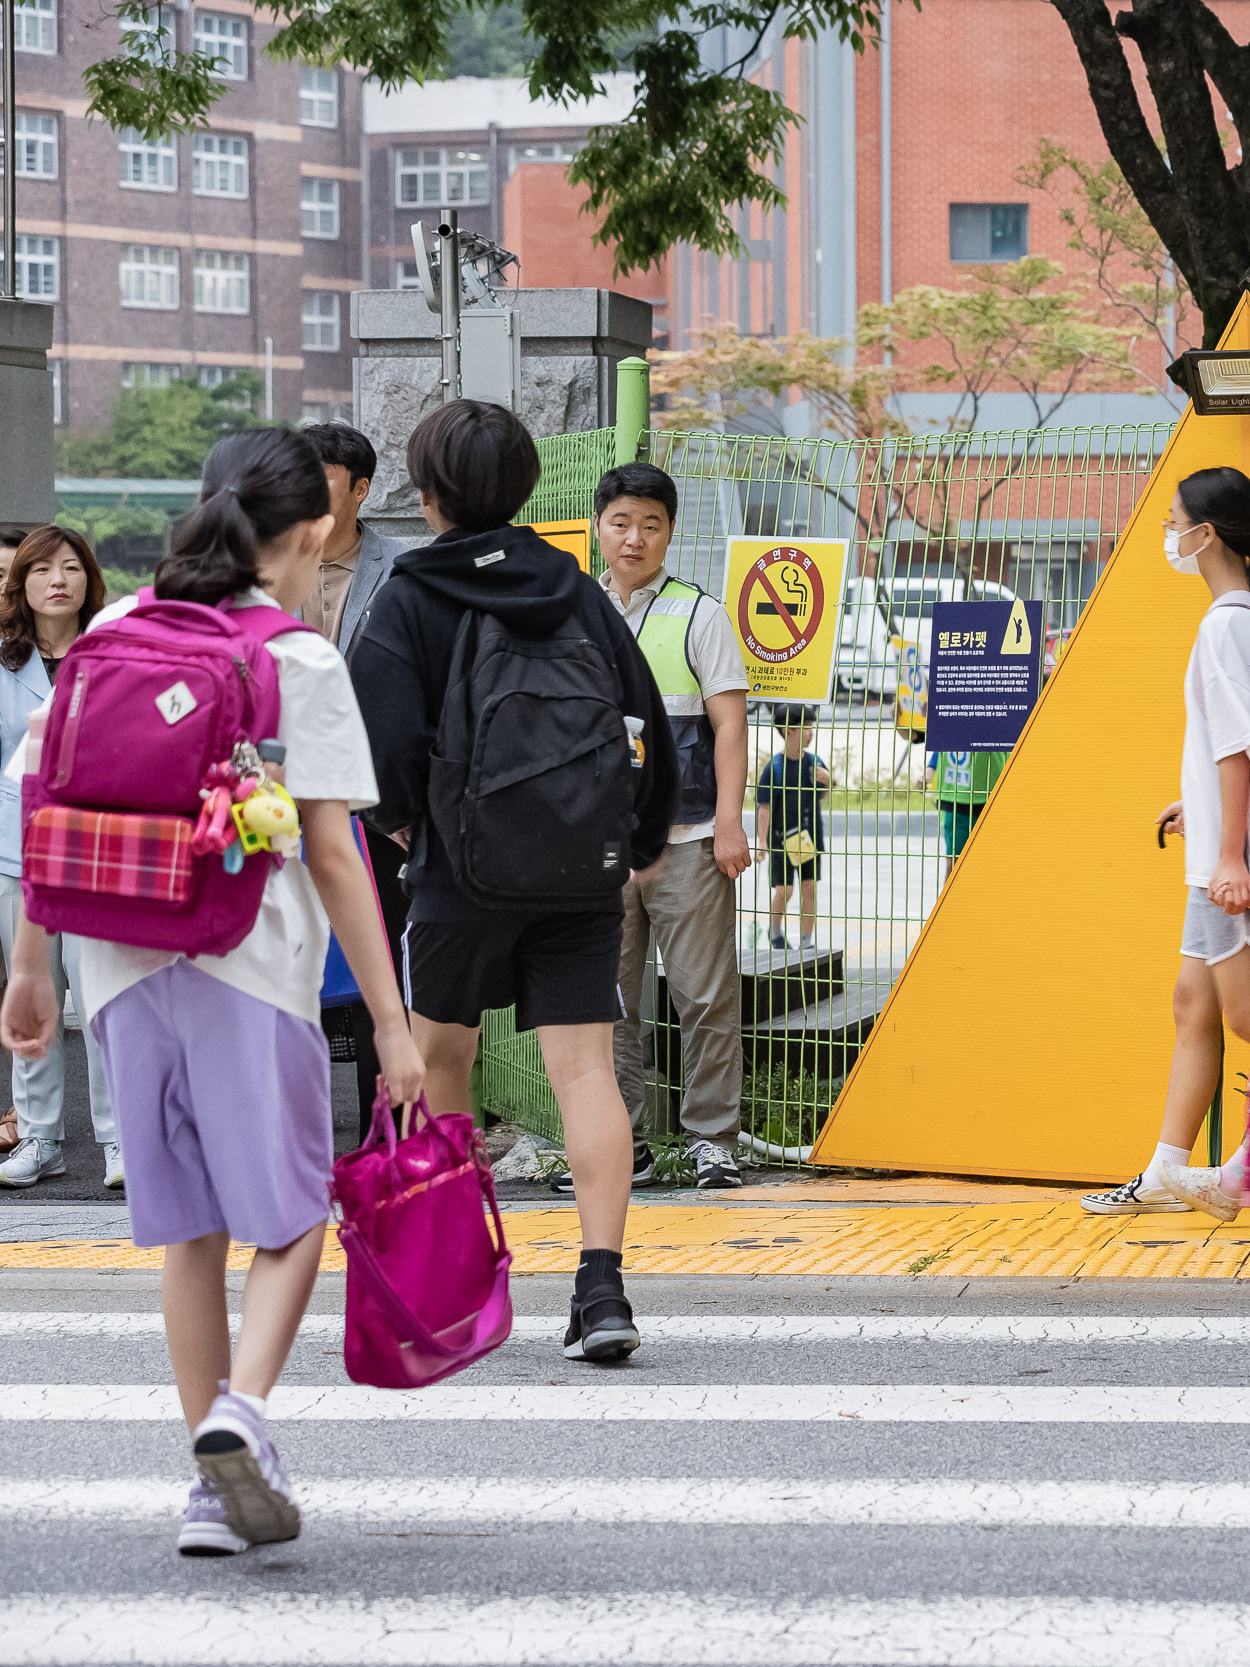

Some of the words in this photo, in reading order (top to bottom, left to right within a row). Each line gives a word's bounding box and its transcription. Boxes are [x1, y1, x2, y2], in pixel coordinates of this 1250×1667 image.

[757, 548, 813, 572] 금연구역
[746, 635, 756, 650] No
[755, 646, 788, 661] Smoking
[789, 637, 807, 657] Area
[938, 630, 987, 649] 옐로카펫
[751, 666, 757, 674] 시
[776, 667, 795, 676] 10만원
[796, 668, 808, 677] 부과
[191, 1497, 222, 1509] FILA
